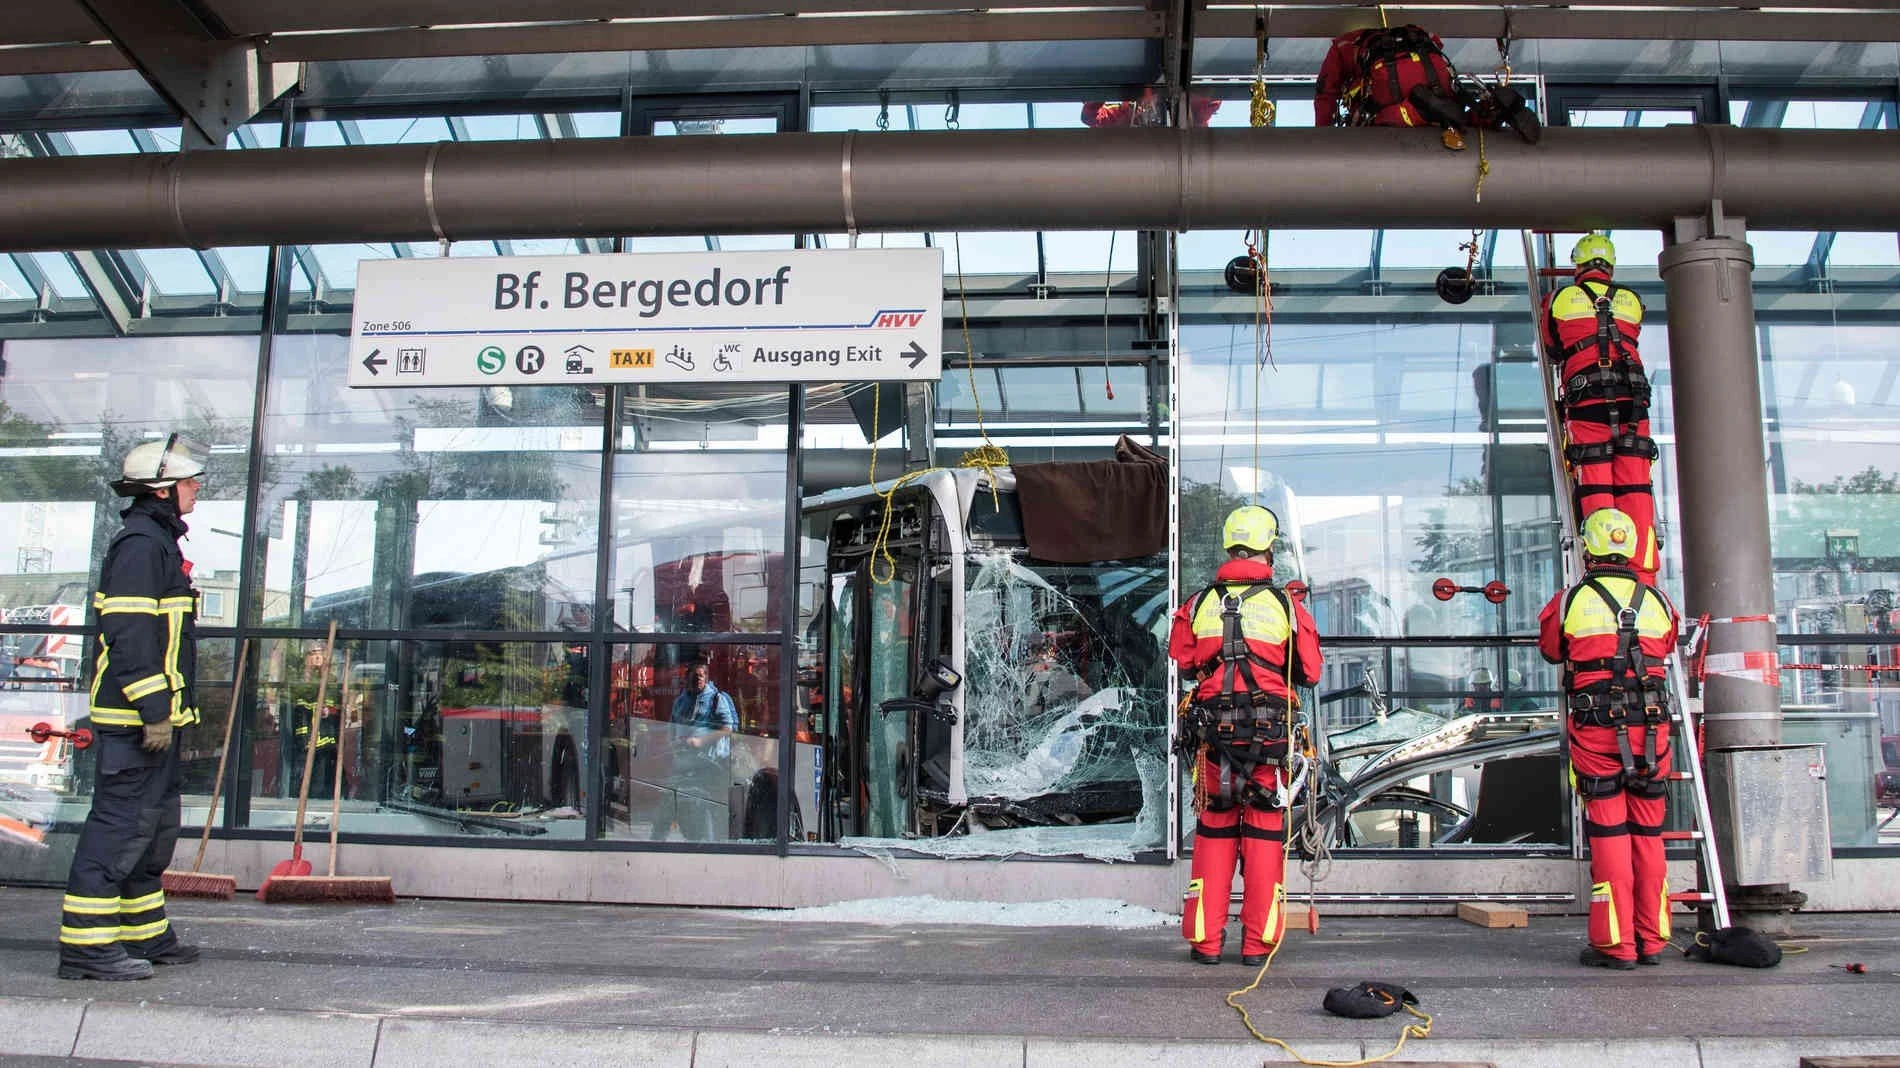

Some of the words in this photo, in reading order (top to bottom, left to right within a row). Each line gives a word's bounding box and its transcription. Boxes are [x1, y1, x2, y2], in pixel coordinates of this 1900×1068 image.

[494, 270, 549, 310] Bf.
[563, 265, 792, 319] Bergedorf
[362, 321, 390, 332] Zone
[391, 320, 412, 331] 506
[877, 314, 923, 328] HVV
[724, 344, 741, 353] WC
[752, 345, 841, 366] Ausgang
[846, 345, 883, 362] Exit
[613, 352, 652, 366] TAXI
